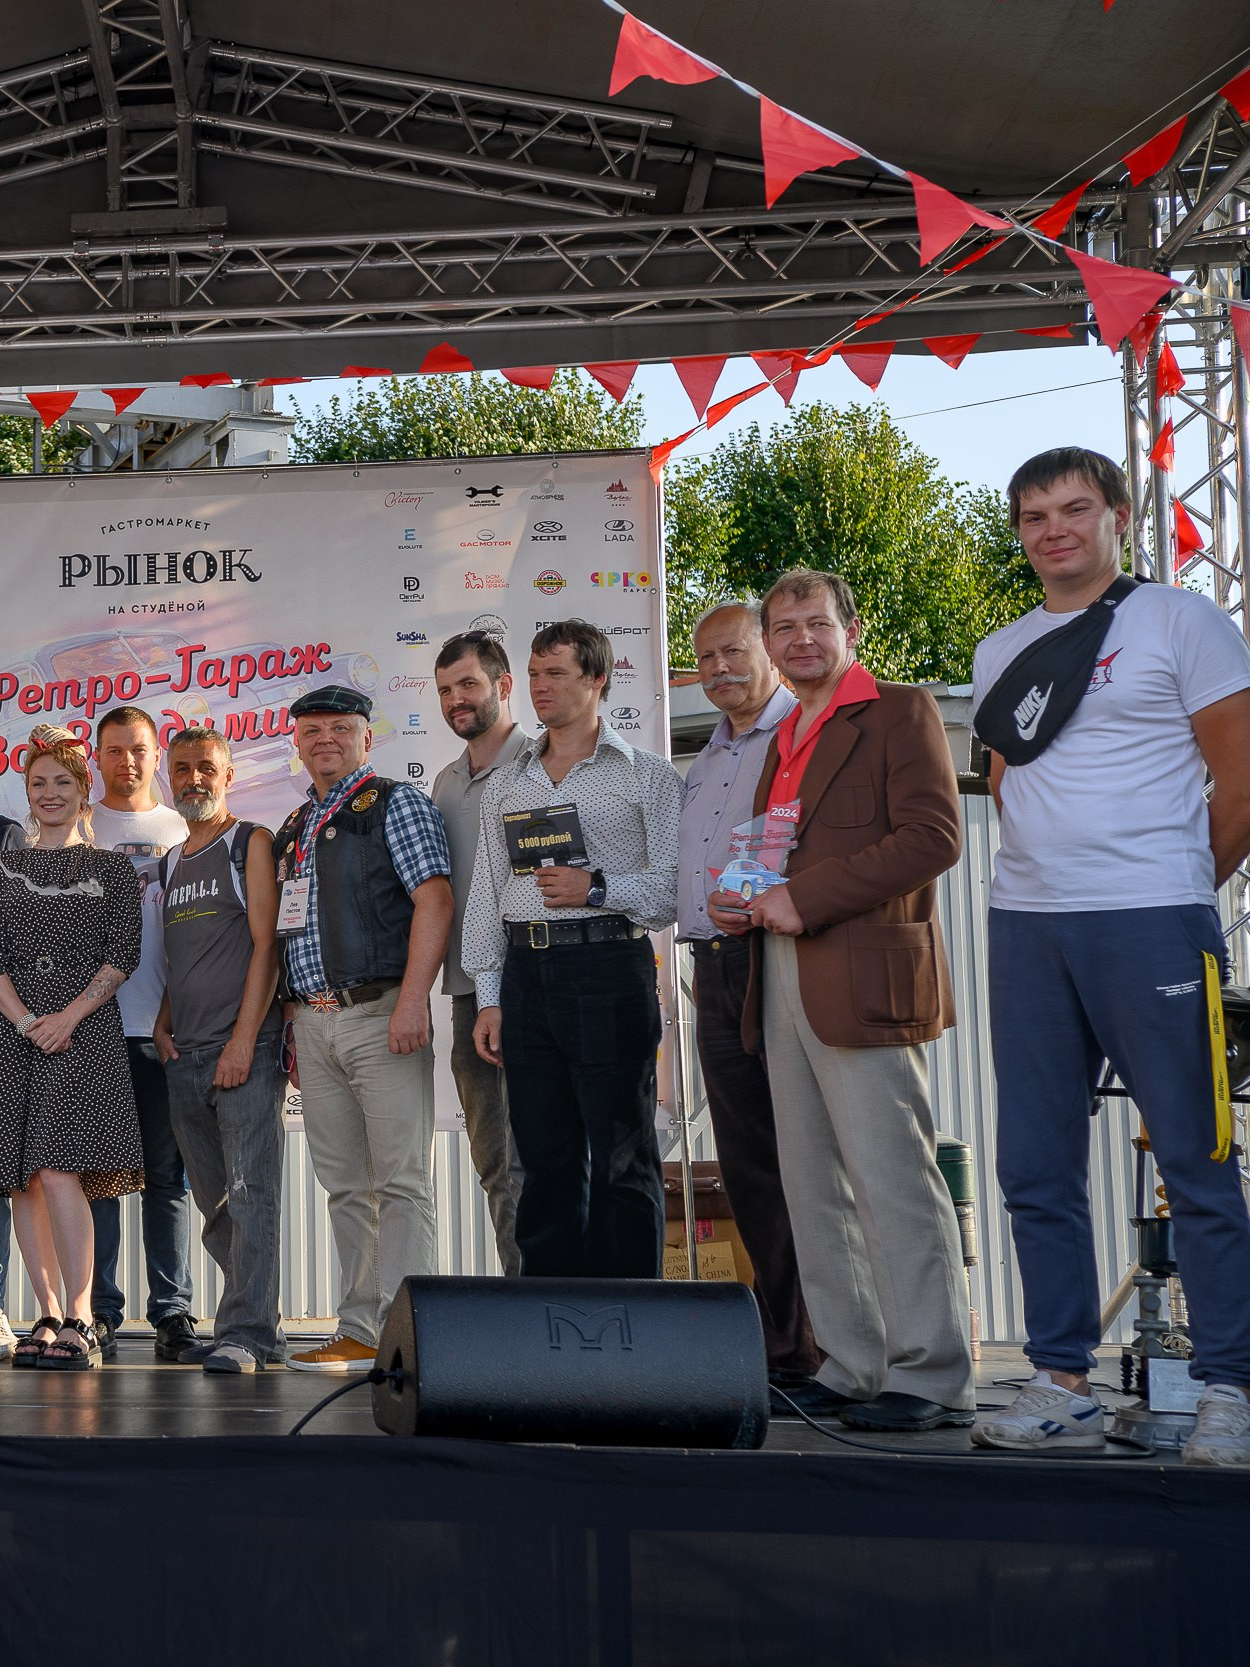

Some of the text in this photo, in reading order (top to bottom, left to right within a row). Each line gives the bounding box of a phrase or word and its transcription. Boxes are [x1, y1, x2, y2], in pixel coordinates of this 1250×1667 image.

[385, 491, 423, 510] Victory
[101, 517, 211, 535] ГАСТРОМАРКЕТ
[604, 534, 634, 542] LADA
[58, 549, 263, 588] РЫНОК
[590, 571, 652, 588] ЯРКО
[108, 600, 205, 615] НА СТУДЁНОЙ
[388, 676, 429, 695] Victory
[1013, 685, 1046, 728] NIKE
[610, 722, 641, 730] LADA
[771, 807, 798, 818] 2024
[518, 831, 572, 849] 5 000 рублей
[706, 1269, 732, 1280] CHINA
